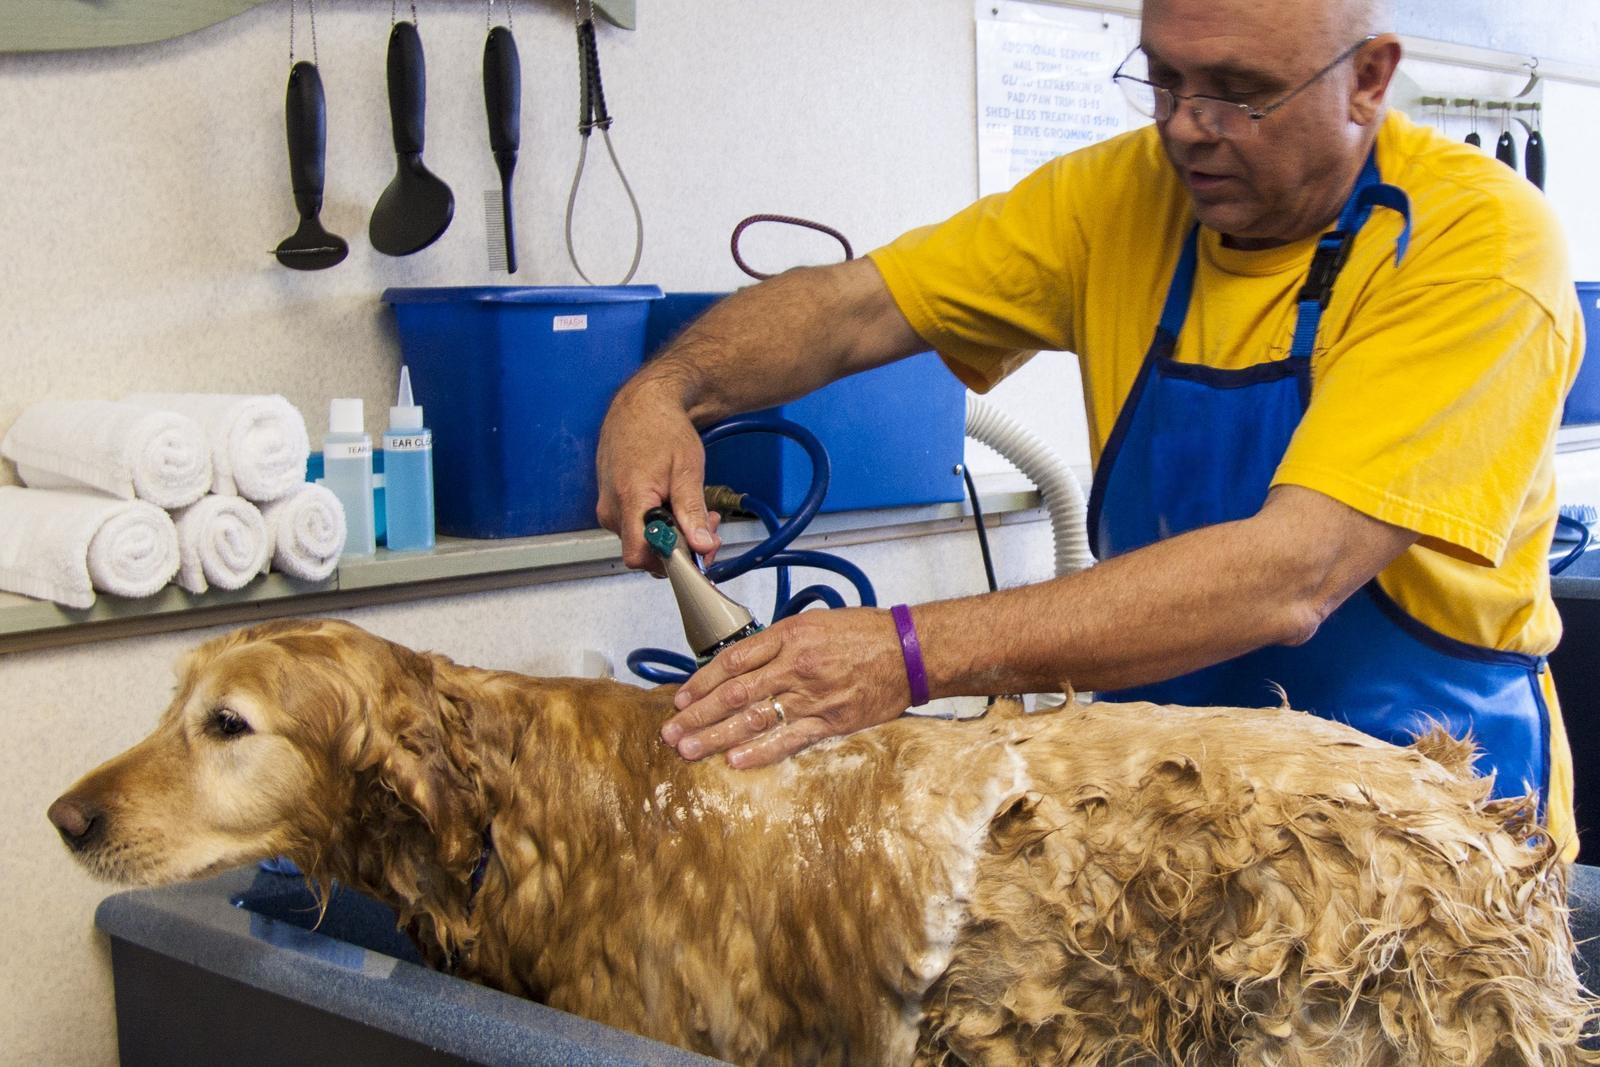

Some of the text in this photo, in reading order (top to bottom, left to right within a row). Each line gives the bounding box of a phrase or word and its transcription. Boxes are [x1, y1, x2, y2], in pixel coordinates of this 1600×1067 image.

[985, 105, 1036, 121] SHED-LESS
[1040, 110, 1091, 125] TREATMENT
[1012, 125, 1041, 138] SERVE
[1043, 127, 1094, 141] GROOMING
[392, 438, 412, 448] EAR
